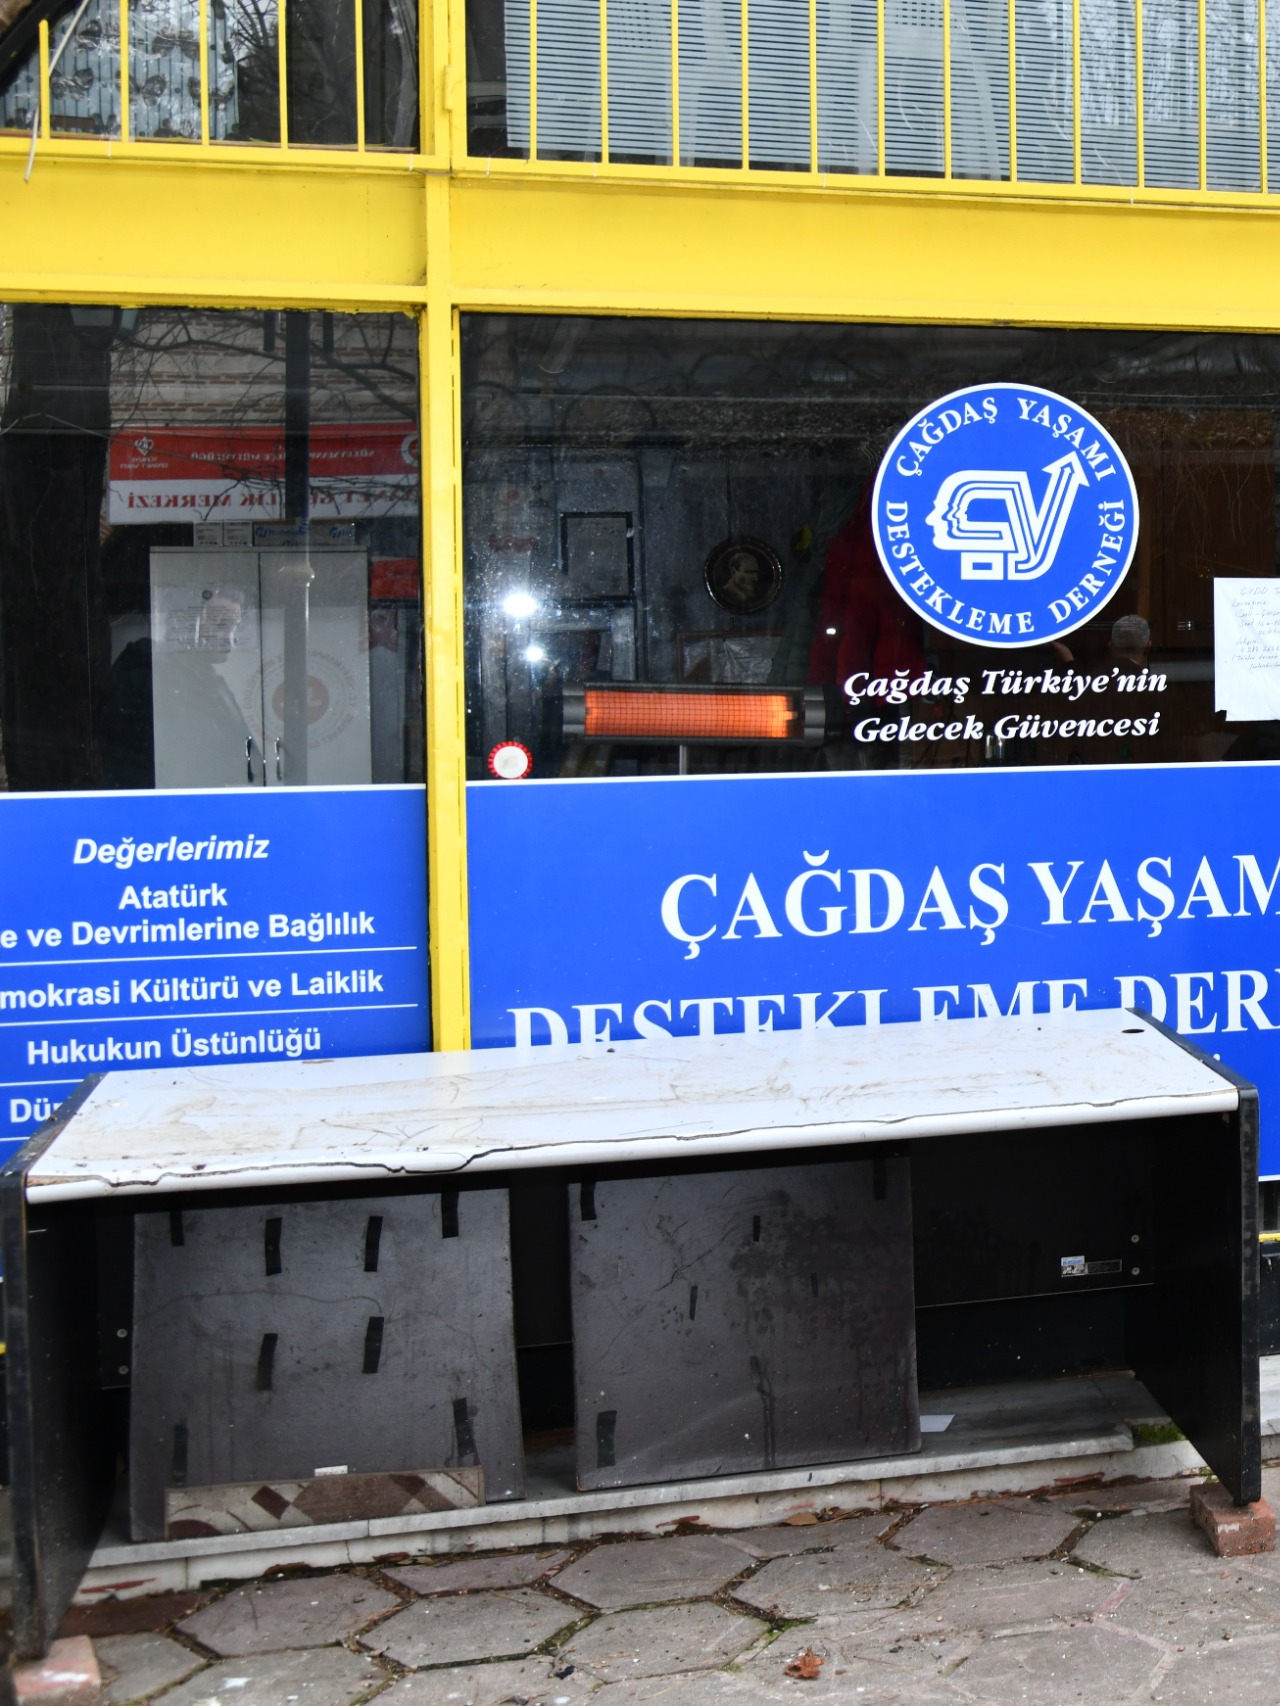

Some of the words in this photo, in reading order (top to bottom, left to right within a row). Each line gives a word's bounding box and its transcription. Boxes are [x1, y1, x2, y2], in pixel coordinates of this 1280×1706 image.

[896, 396, 999, 478] ÇAĞDAŞ
[1017, 398, 1117, 482] YAŞAMI
[887, 500, 1036, 636] DESTEKLEME
[1047, 500, 1126, 624] DERNEĞİ
[843, 668, 971, 706] Çağdaş
[853, 716, 985, 743] Gelecek
[995, 711, 1161, 741] Güvencesi
[73, 833, 270, 870] Değerlerimiz
[118, 883, 229, 910] Atatürk
[660, 849, 1009, 960] ÇAĞDAŞ
[0, 928, 18, 949] e
[26, 928, 62, 948] ve
[72, 916, 260, 947] Devrimlerine
[269, 911, 375, 943] Bağlılık
[0, 980, 121, 1010] mokrasi
[130, 975, 239, 1003] Kültürü
[247, 979, 282, 999] ve
[291, 969, 384, 997] Laiklik
[27, 1033, 161, 1065] Hukukun
[171, 1027, 321, 1060] Üstünlüğü
[10, 1097, 62, 1123] Dü
